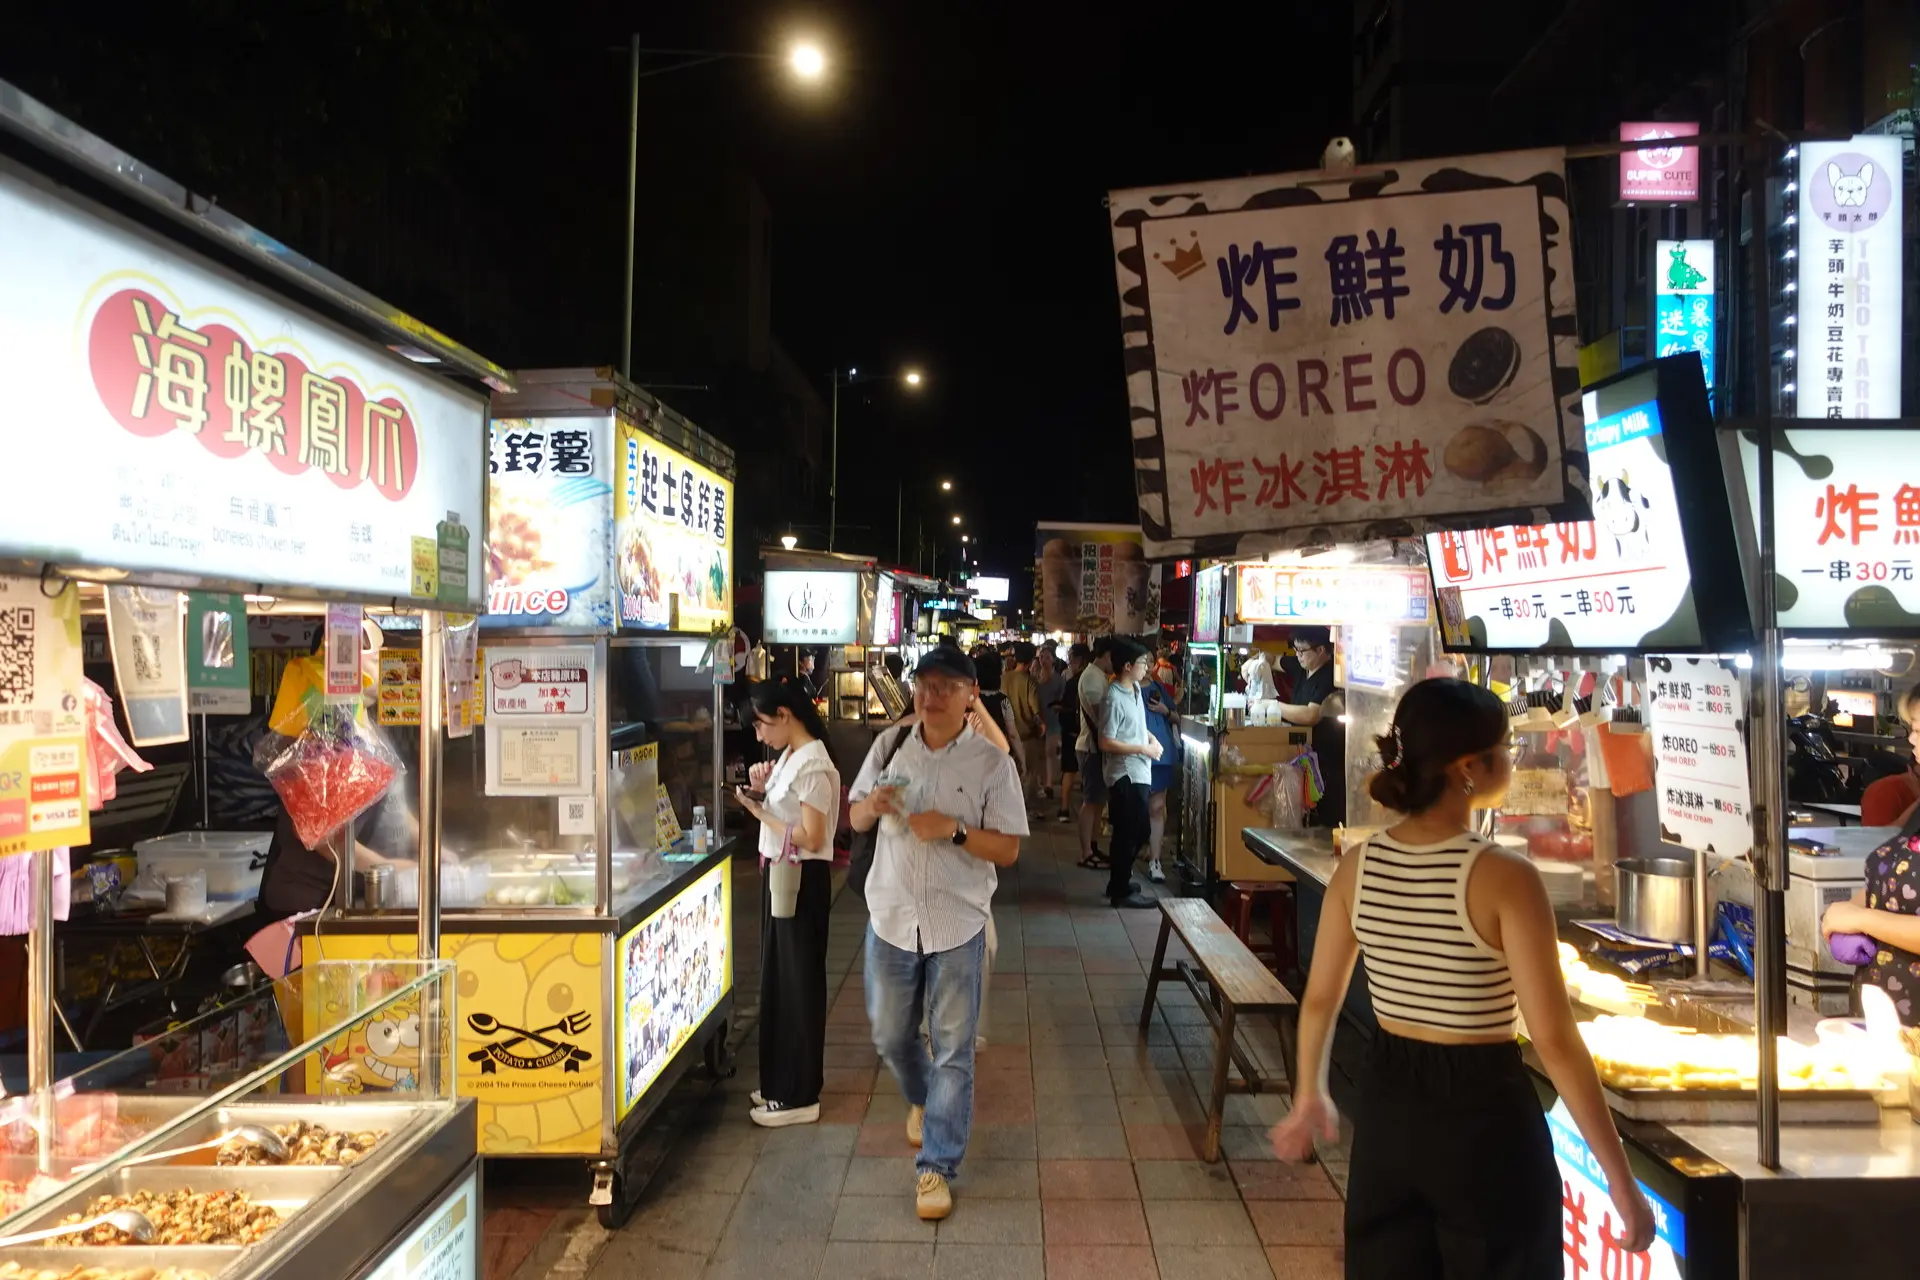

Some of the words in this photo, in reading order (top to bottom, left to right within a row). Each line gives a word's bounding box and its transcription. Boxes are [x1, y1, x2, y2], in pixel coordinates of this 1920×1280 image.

[1664, 171, 1692, 180] CUTE
[1823, 212, 1878, 222] 芋頭太郎
[1216, 222, 1516, 335] 炸鮮奶
[130, 297, 404, 491] 海螺鳳爪
[1181, 347, 1427, 427] 炸OREO
[1621, 411, 1650, 435] Milk
[490, 429, 591, 475] 鈴薯
[1189, 439, 1433, 517] 炸冰淇淋
[641, 449, 725, 541] 起士馬鈴薯
[1801, 560, 1914, 582] 一串30元
[1489, 594, 1547, 620] 一串30元
[1560, 586, 1636, 616] 二串50元
[537, 686, 572, 698] 加拿大
[1656, 680, 1692, 700] 炸鮮奶
[497, 698, 528, 710] 原產地
[544, 701, 566, 713] 台灣
[1658, 701, 1676, 712] Crispy
[1677, 702, 1691, 712] Milk
[1661, 733, 1698, 754] 炸OREO
[1662, 754, 1678, 764] Fried
[1678, 756, 1697, 767] OREO
[1666, 788, 1704, 810] 炸冰淇淋
[1667, 806, 1683, 819] Fried
[493, 1046, 525, 1068] POTATO
[536, 1046, 567, 1068] CHEESE
[475, 1081, 494, 1089] 2004
[496, 1081, 510, 1089] The
[511, 1081, 537, 1089] Prince
[538, 1081, 567, 1089] Cheese
[569, 1080, 594, 1089] Potato
